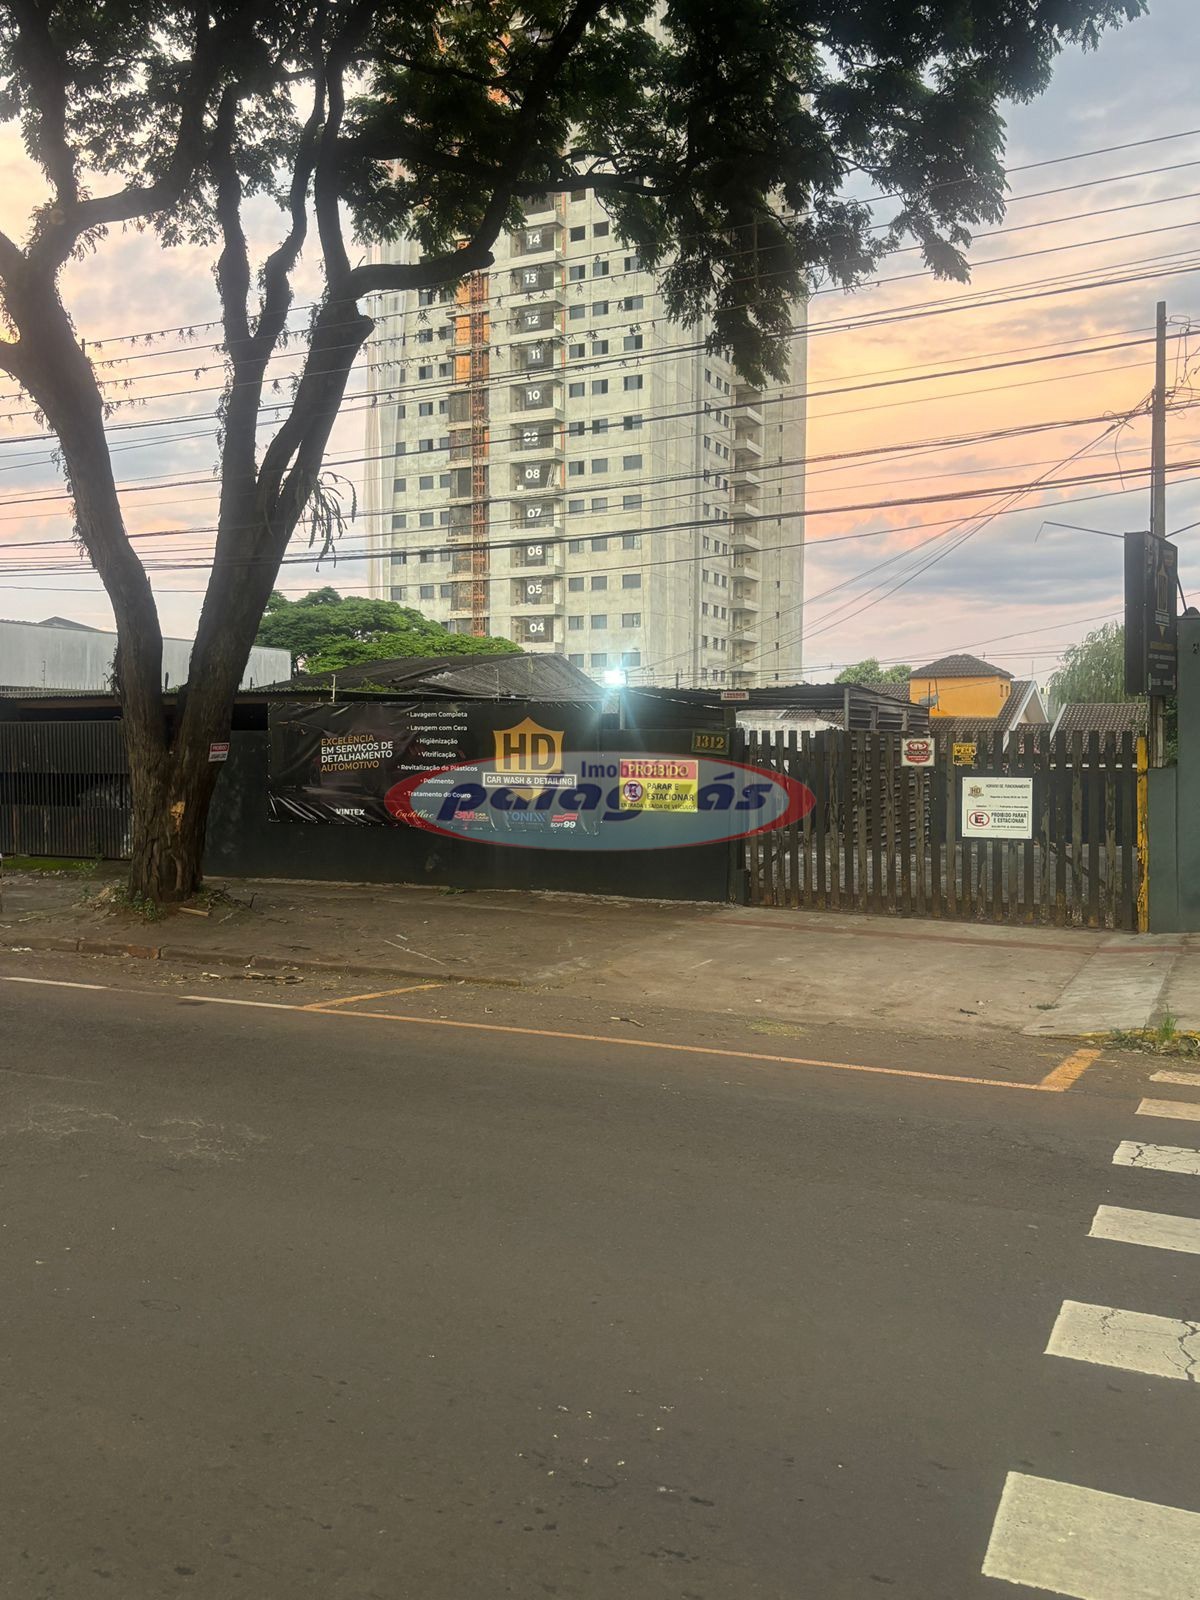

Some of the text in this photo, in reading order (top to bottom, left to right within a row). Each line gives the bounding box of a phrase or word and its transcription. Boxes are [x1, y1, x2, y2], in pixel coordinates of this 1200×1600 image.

[528, 234, 541, 245] 14
[524, 273, 537, 284] 13
[526, 315, 539, 325] 12
[531, 349, 541, 359] 11
[527, 390, 540, 401] 10
[525, 469, 541, 479] 08
[527, 508, 542, 519] 07
[527, 546, 542, 556] 06
[527, 584, 542, 594] 05
[529, 623, 545, 633] 04
[696, 735, 725, 748] 1312
[321, 741, 394, 755] EM SERVIÇOS DE
[504, 734, 556, 770] HD
[321, 750, 393, 763] DETALHAMENTO
[321, 760, 380, 772] AUTOMOTIVO
[628, 764, 689, 776] PROIBIDO
[504, 776, 525, 784] WASH
[534, 777, 572, 785] DETAILING
[646, 793, 695, 801] ESTACIONAR
[336, 808, 365, 816] VINTEX
[454, 811, 475, 819] 3M
